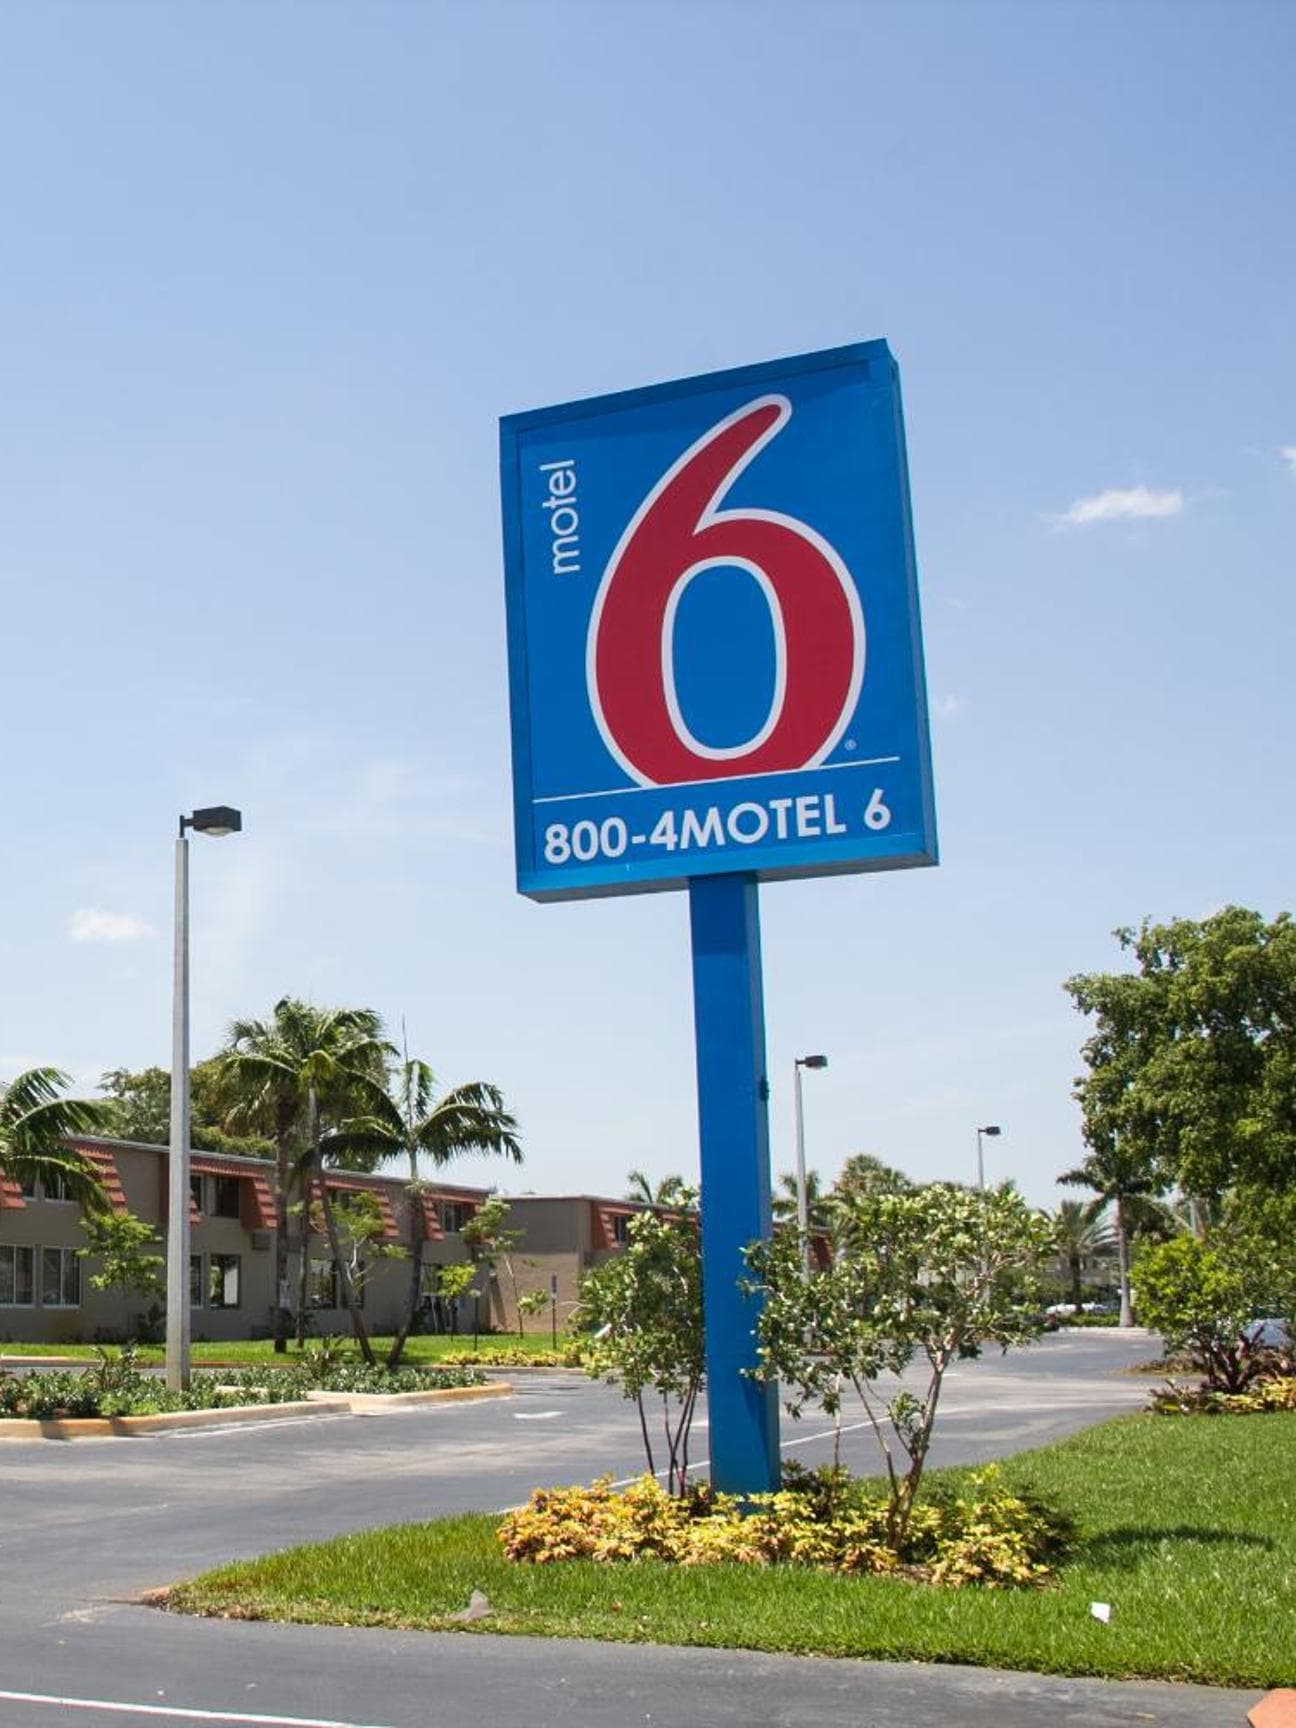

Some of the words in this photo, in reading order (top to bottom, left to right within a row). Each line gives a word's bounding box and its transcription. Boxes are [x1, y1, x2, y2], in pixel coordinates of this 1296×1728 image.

[539, 459, 581, 575] motel
[585, 393, 867, 788] 6
[544, 793, 847, 864] 800-4MOTEL
[863, 788, 891, 831] 6
